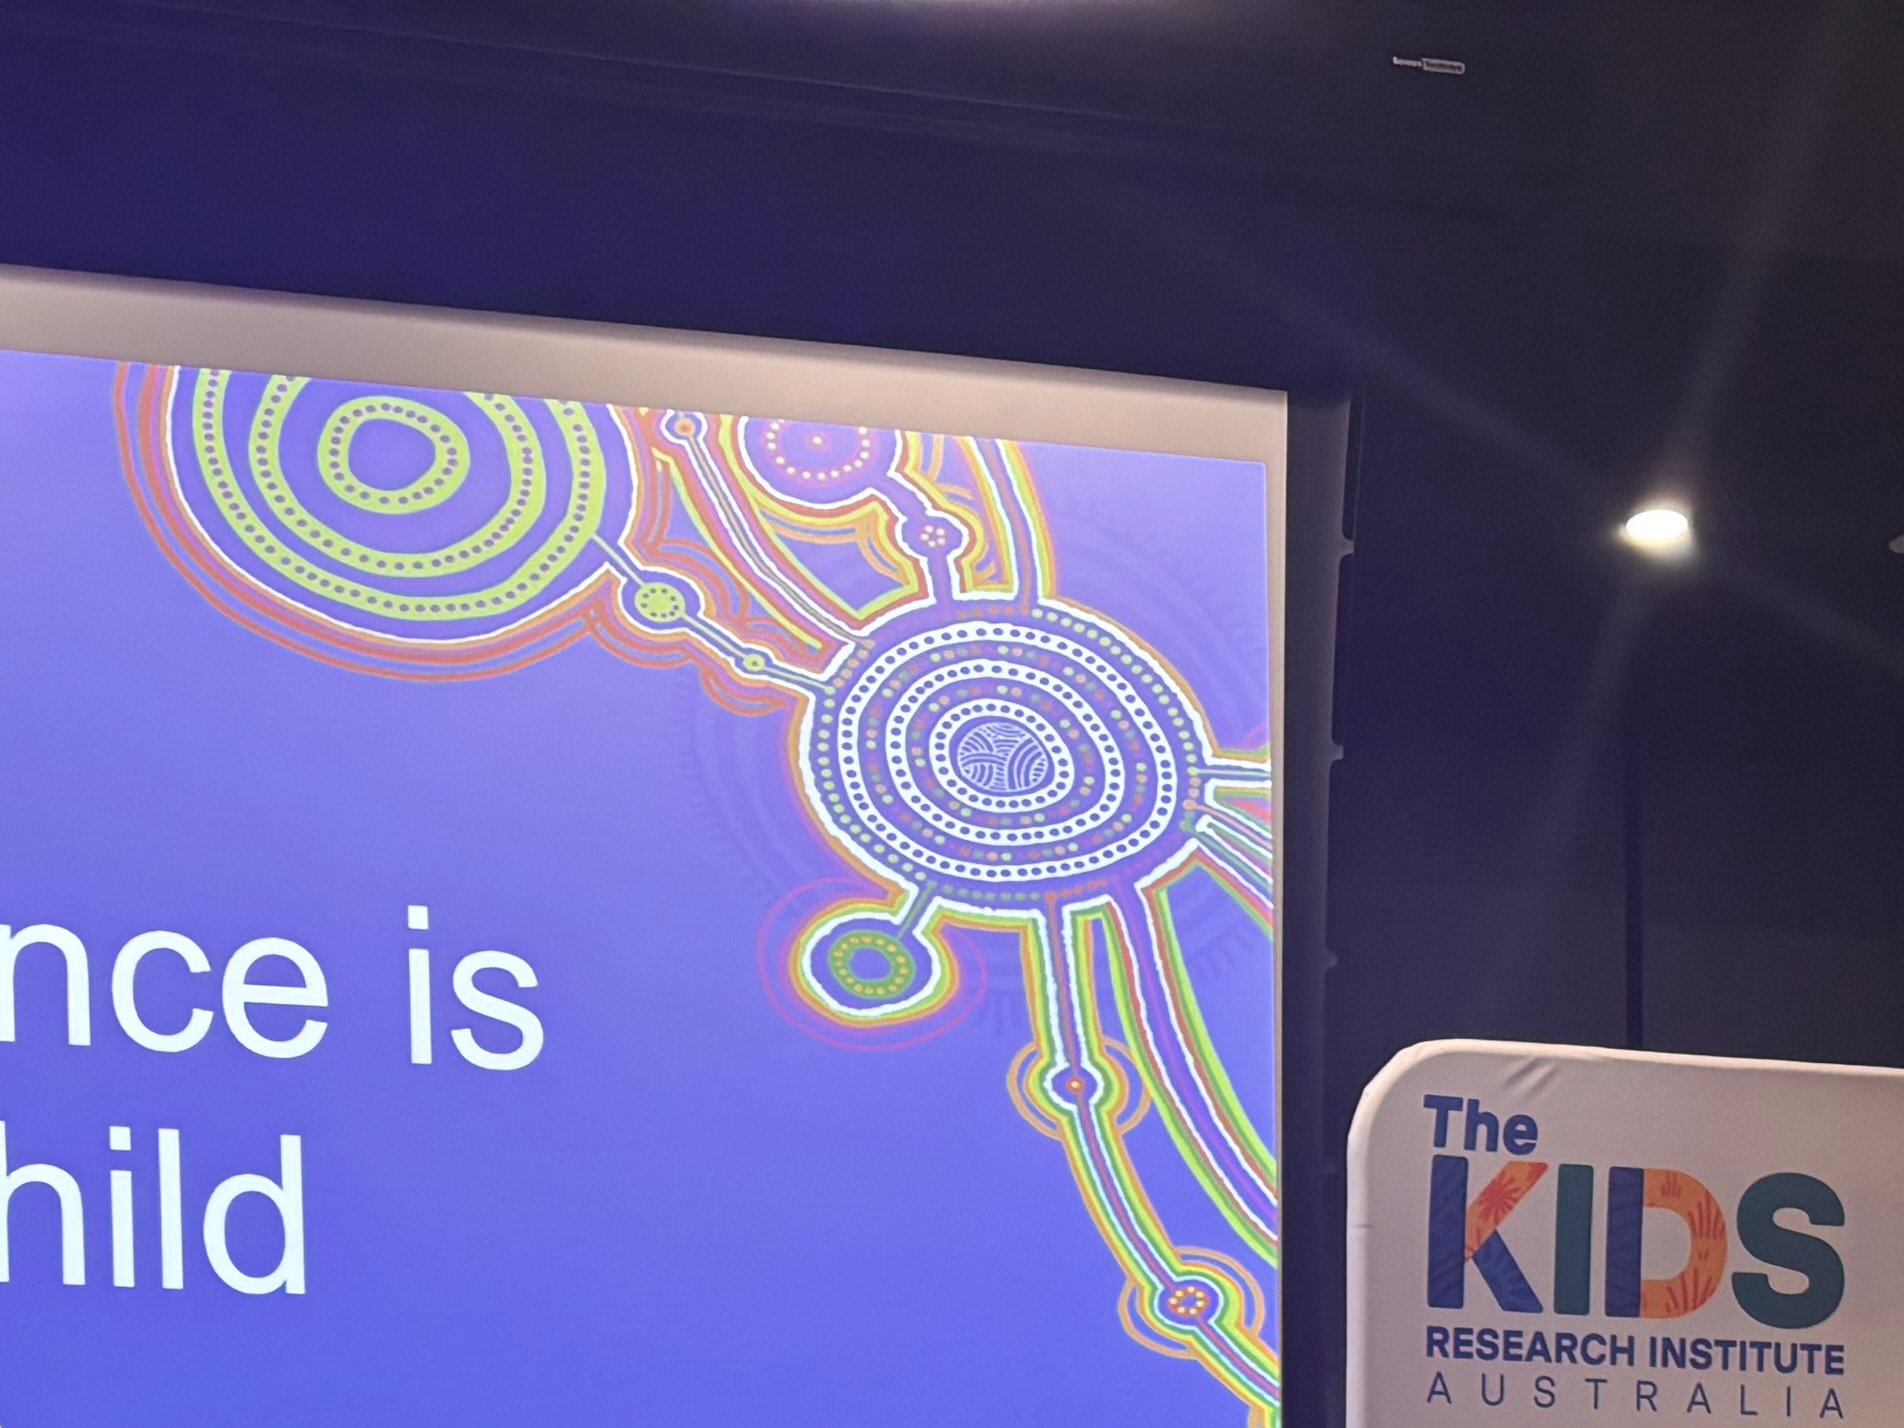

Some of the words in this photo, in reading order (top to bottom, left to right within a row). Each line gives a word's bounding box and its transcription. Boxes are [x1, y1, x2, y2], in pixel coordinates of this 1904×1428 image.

[405, 905, 546, 1072] is
[1423, 1094, 1538, 1155] The
[1427, 1155, 1845, 1329] KIDS
[1426, 1327, 1634, 1367] RESEARCH
[1649, 1337, 1845, 1375] INSTITUTE
[1427, 1373, 1845, 1420] AUSTRALIA
